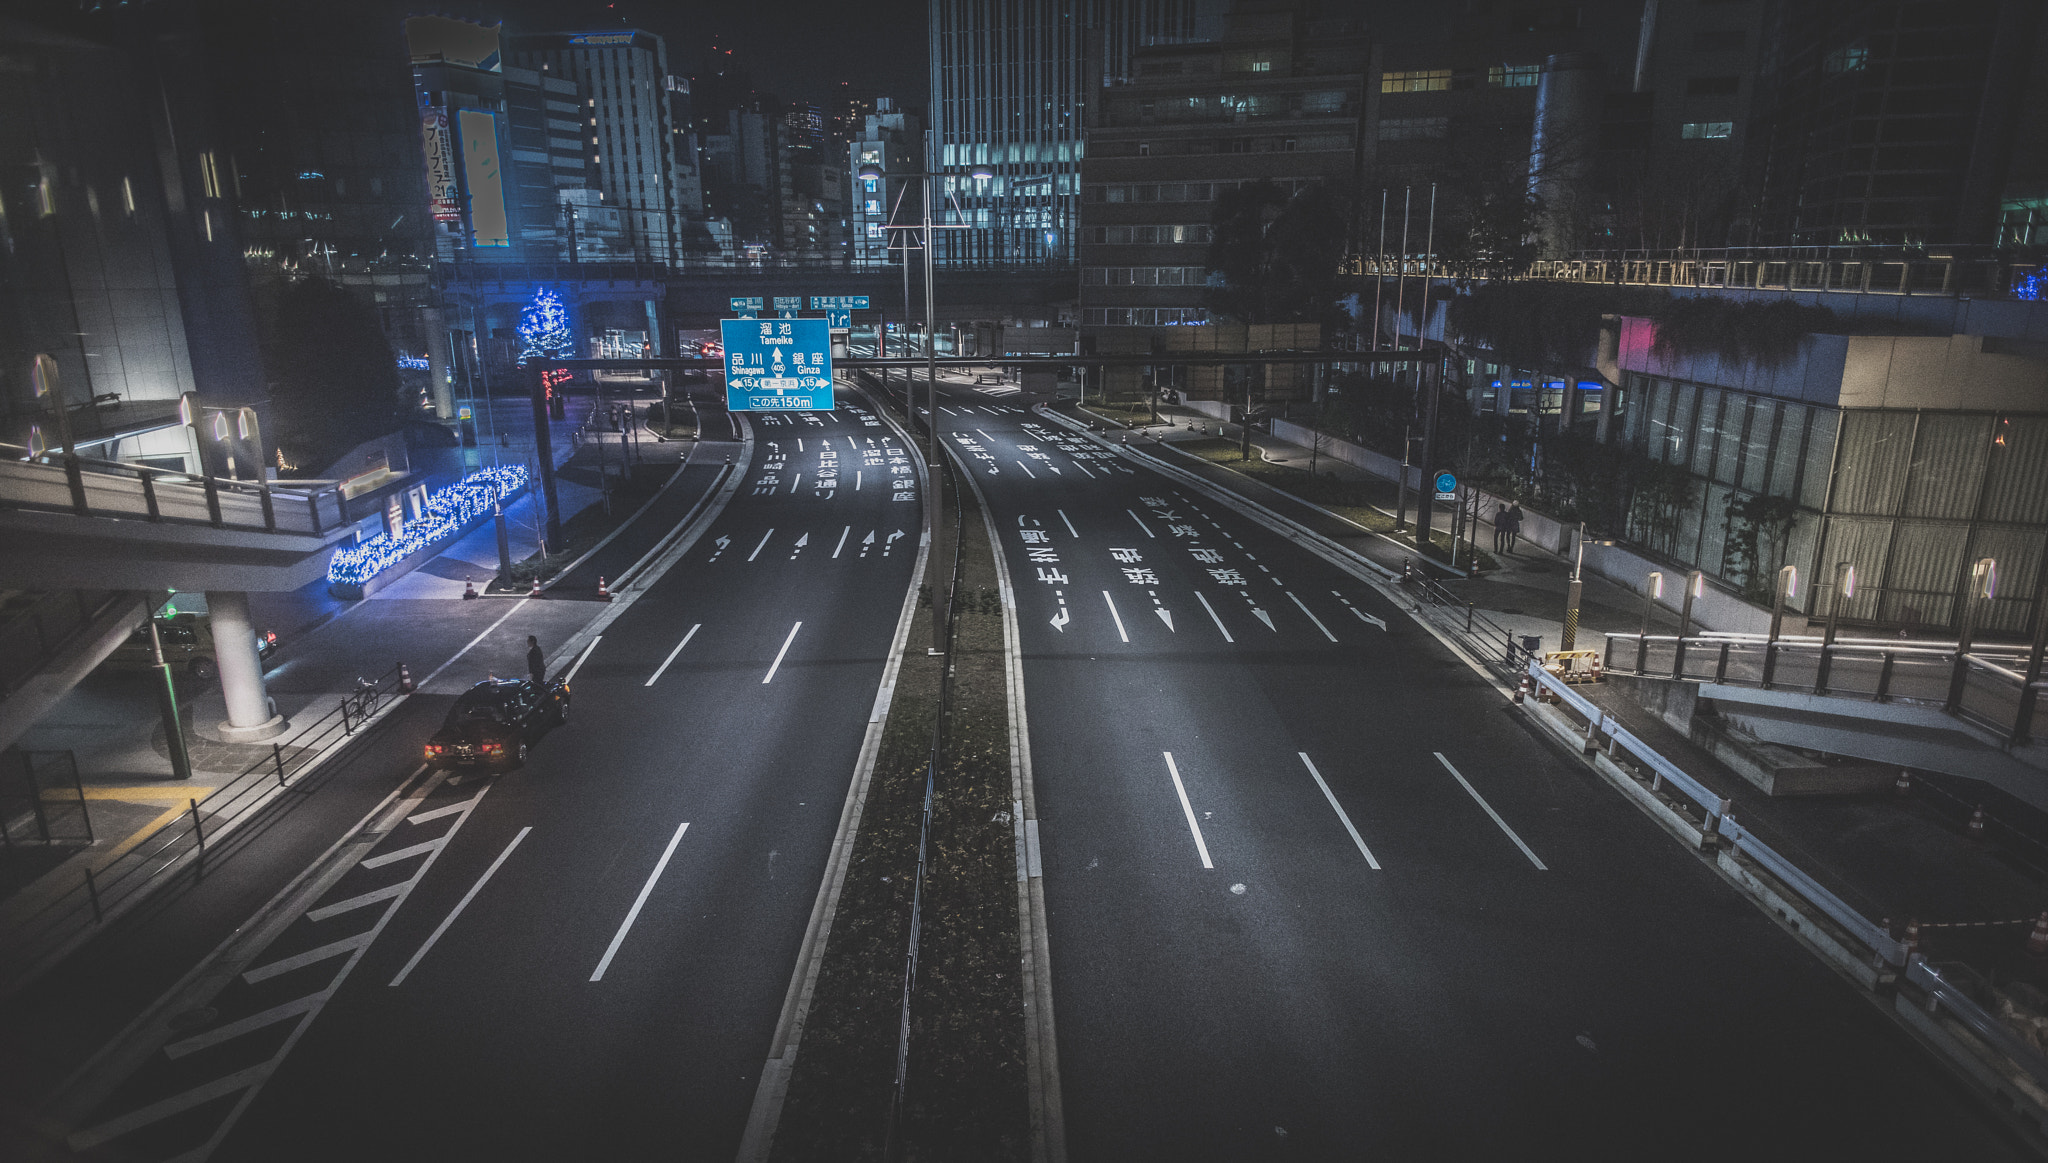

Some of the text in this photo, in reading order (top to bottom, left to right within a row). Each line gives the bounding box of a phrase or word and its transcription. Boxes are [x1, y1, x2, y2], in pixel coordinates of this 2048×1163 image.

[760, 323, 791, 335] 溜池
[760, 336, 793, 345] Tameike
[732, 353, 763, 365] 品川
[792, 352, 824, 365] 銀座
[731, 366, 765, 376] Shinagawa
[797, 366, 820, 374] Ginza
[744, 379, 753, 387] 15
[764, 379, 796, 387] 第一京浜
[805, 378, 815, 387] 15
[863, 449, 885, 466] 溜池
[814, 451, 838, 500] 日比谷通り
[1018, 513, 1069, 585] 竹芝通り
[1108, 547, 1159, 586] 築地
